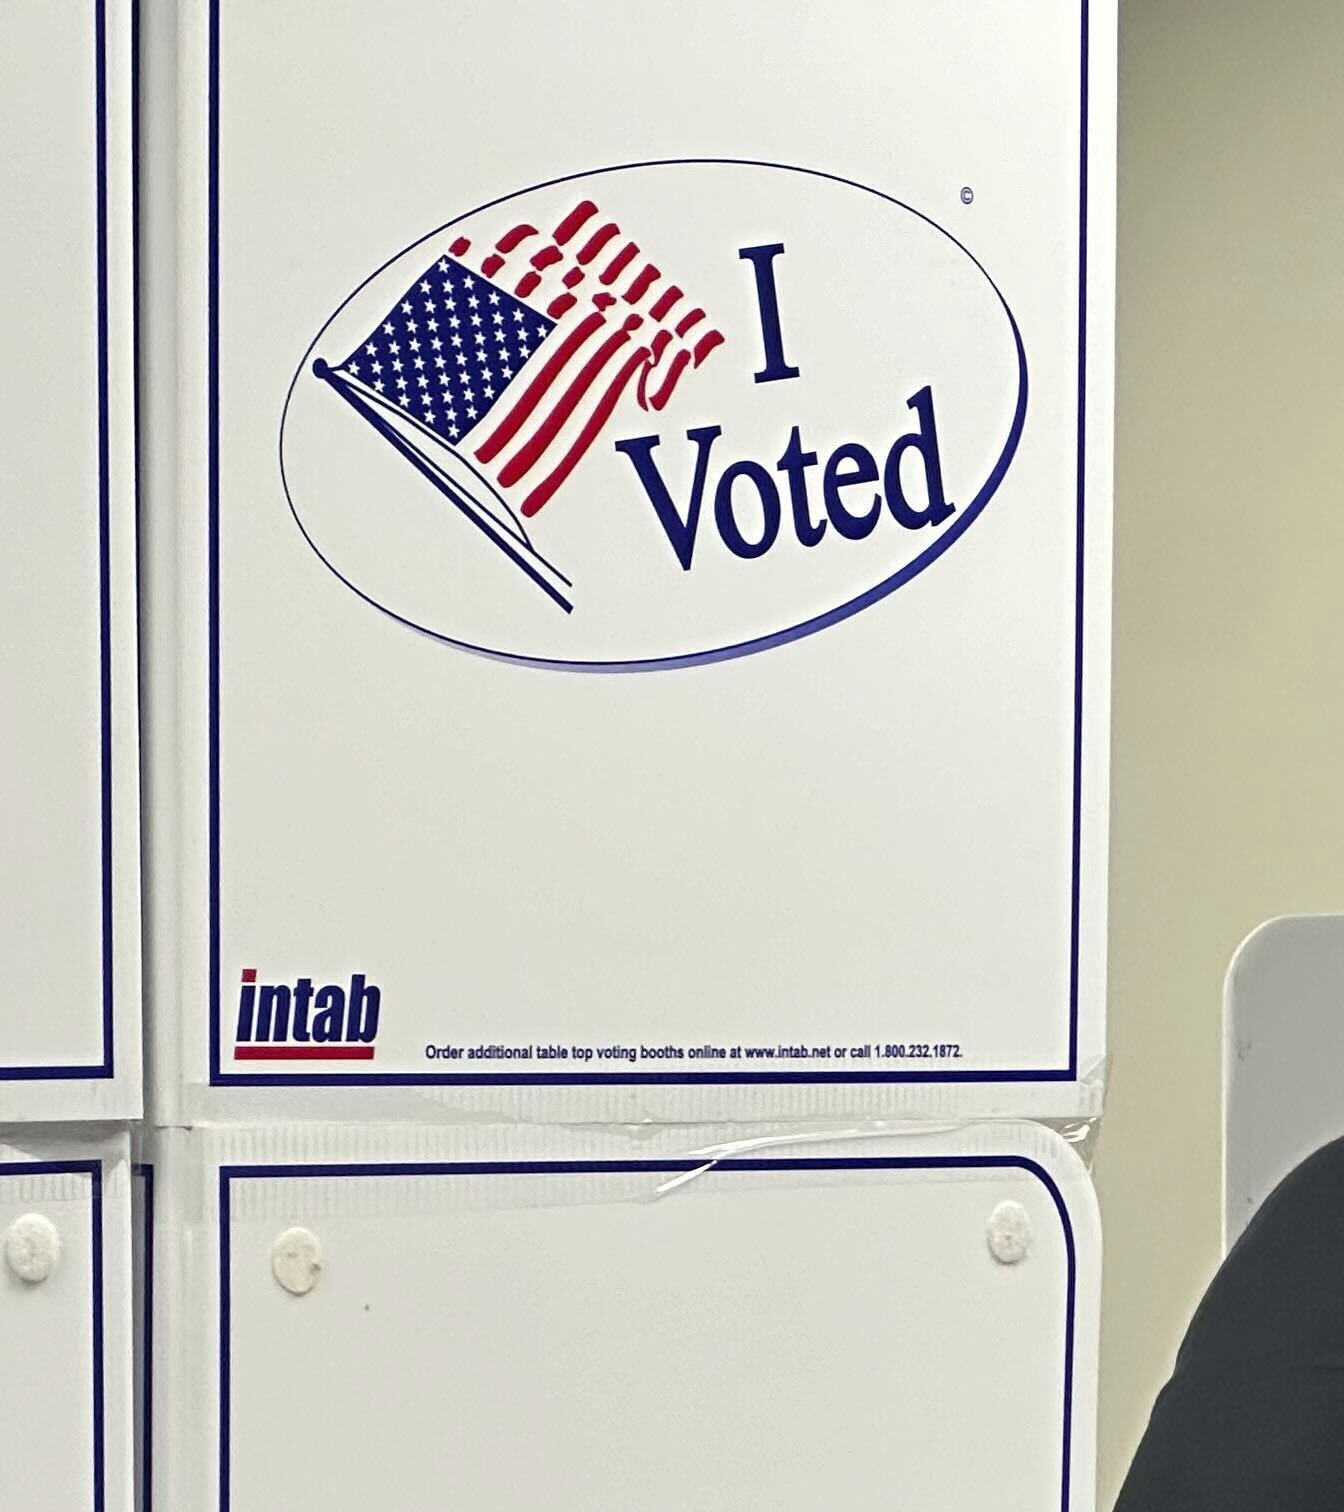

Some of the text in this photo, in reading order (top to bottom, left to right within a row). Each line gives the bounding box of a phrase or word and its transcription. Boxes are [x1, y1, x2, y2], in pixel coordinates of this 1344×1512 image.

[738, 242, 801, 384] I
[615, 385, 957, 572] Voted
[235, 968, 381, 1044] intab
[425, 1044, 464, 1060] Order
[467, 1044, 533, 1060] additional
[536, 1044, 569, 1060] table
[571, 1045, 593, 1062] top
[597, 1044, 637, 1063] voting
[640, 1044, 684, 1060] booths
[688, 1044, 726, 1059] online
[730, 1046, 742, 1059] at
[744, 1044, 831, 1060] www.intab.net
[834, 1048, 847, 1059] or
[850, 1044, 872, 1059] call
